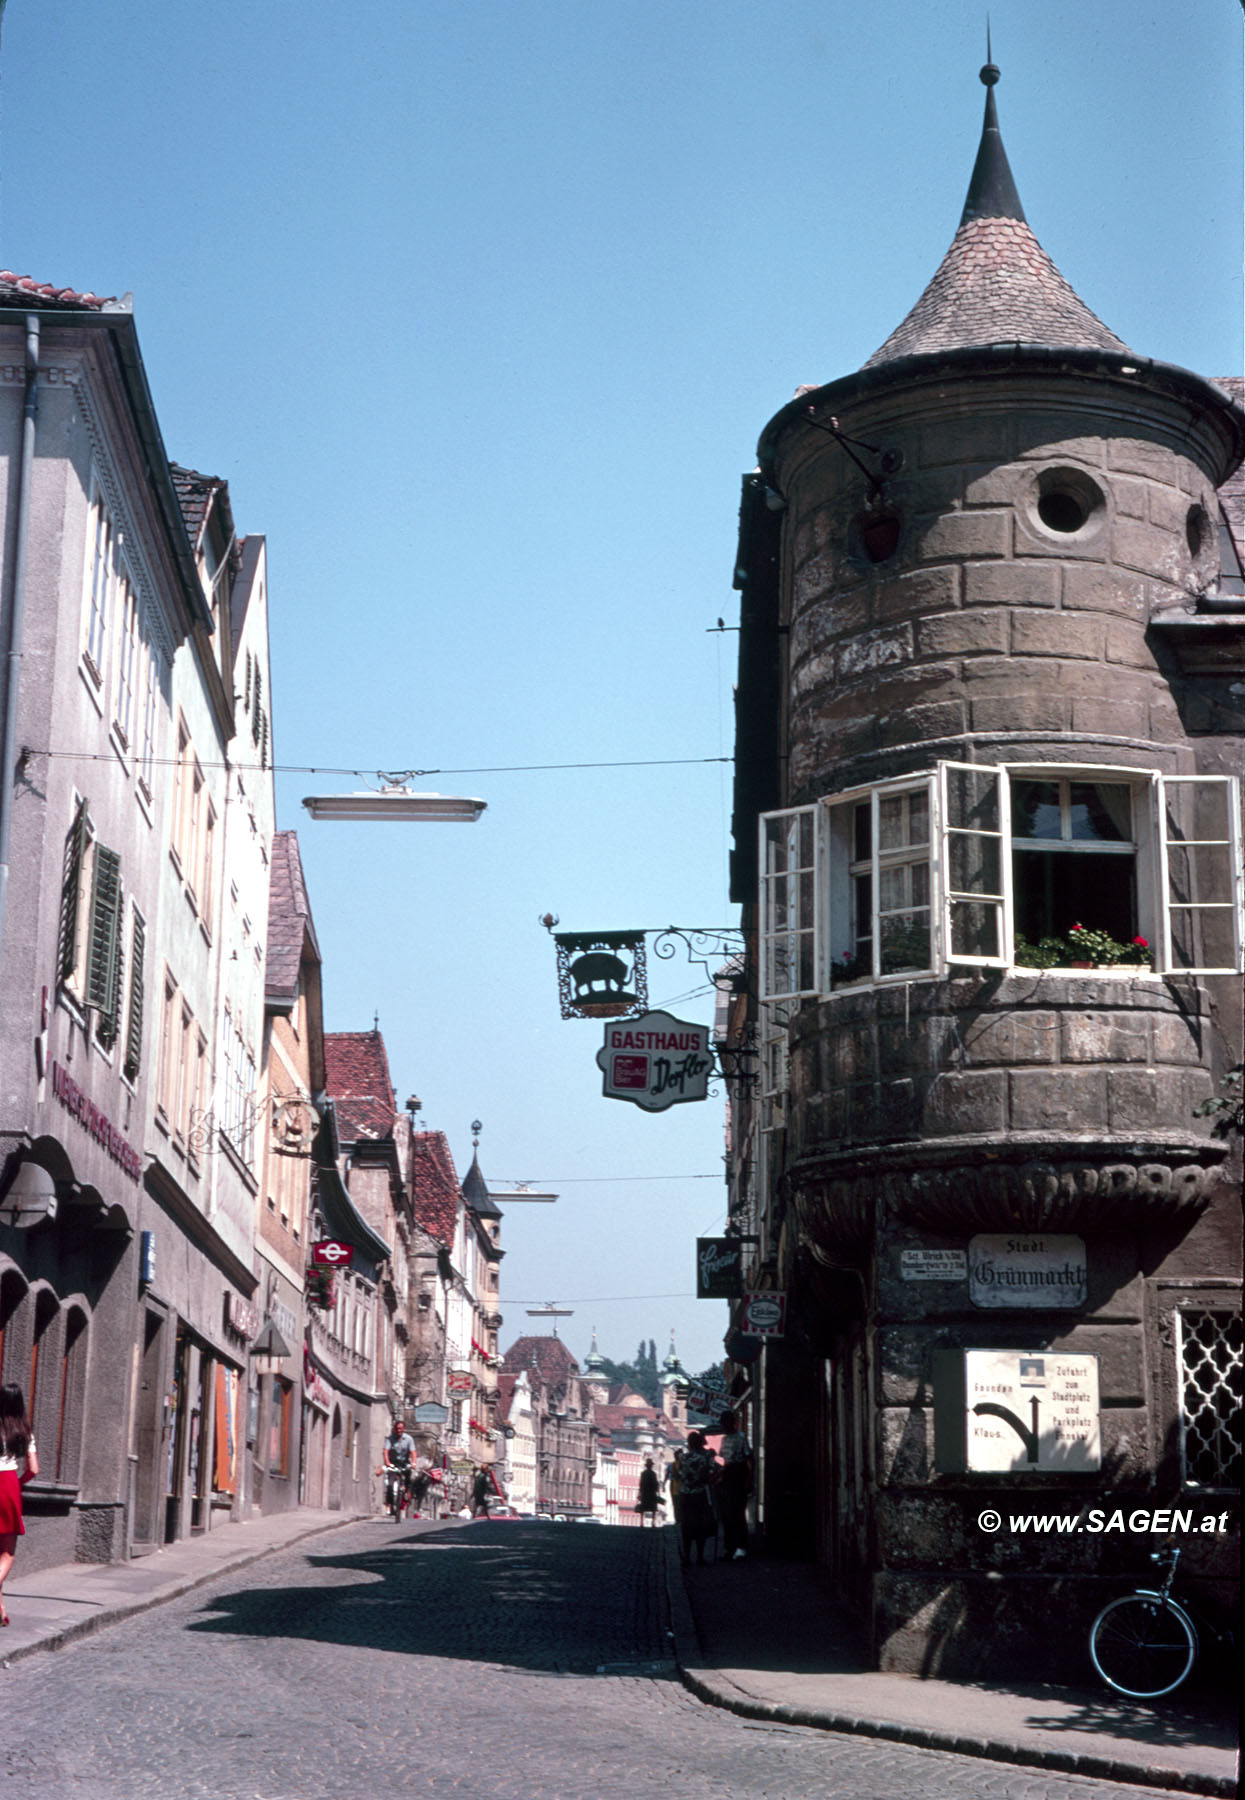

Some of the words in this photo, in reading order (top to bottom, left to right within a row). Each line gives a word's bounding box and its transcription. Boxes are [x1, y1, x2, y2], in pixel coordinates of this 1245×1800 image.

[611, 1031, 700, 1051] GASTHAUS
[975, 1260, 1086, 1286] Grünmarkt
[1056, 1366, 1088, 1377] Zufahrt
[1065, 1381, 1079, 1389] zum
[1052, 1391, 1091, 1403] Stadtplatz
[1065, 1406, 1080, 1415] und
[1053, 1416, 1092, 1428] Parkplatz
